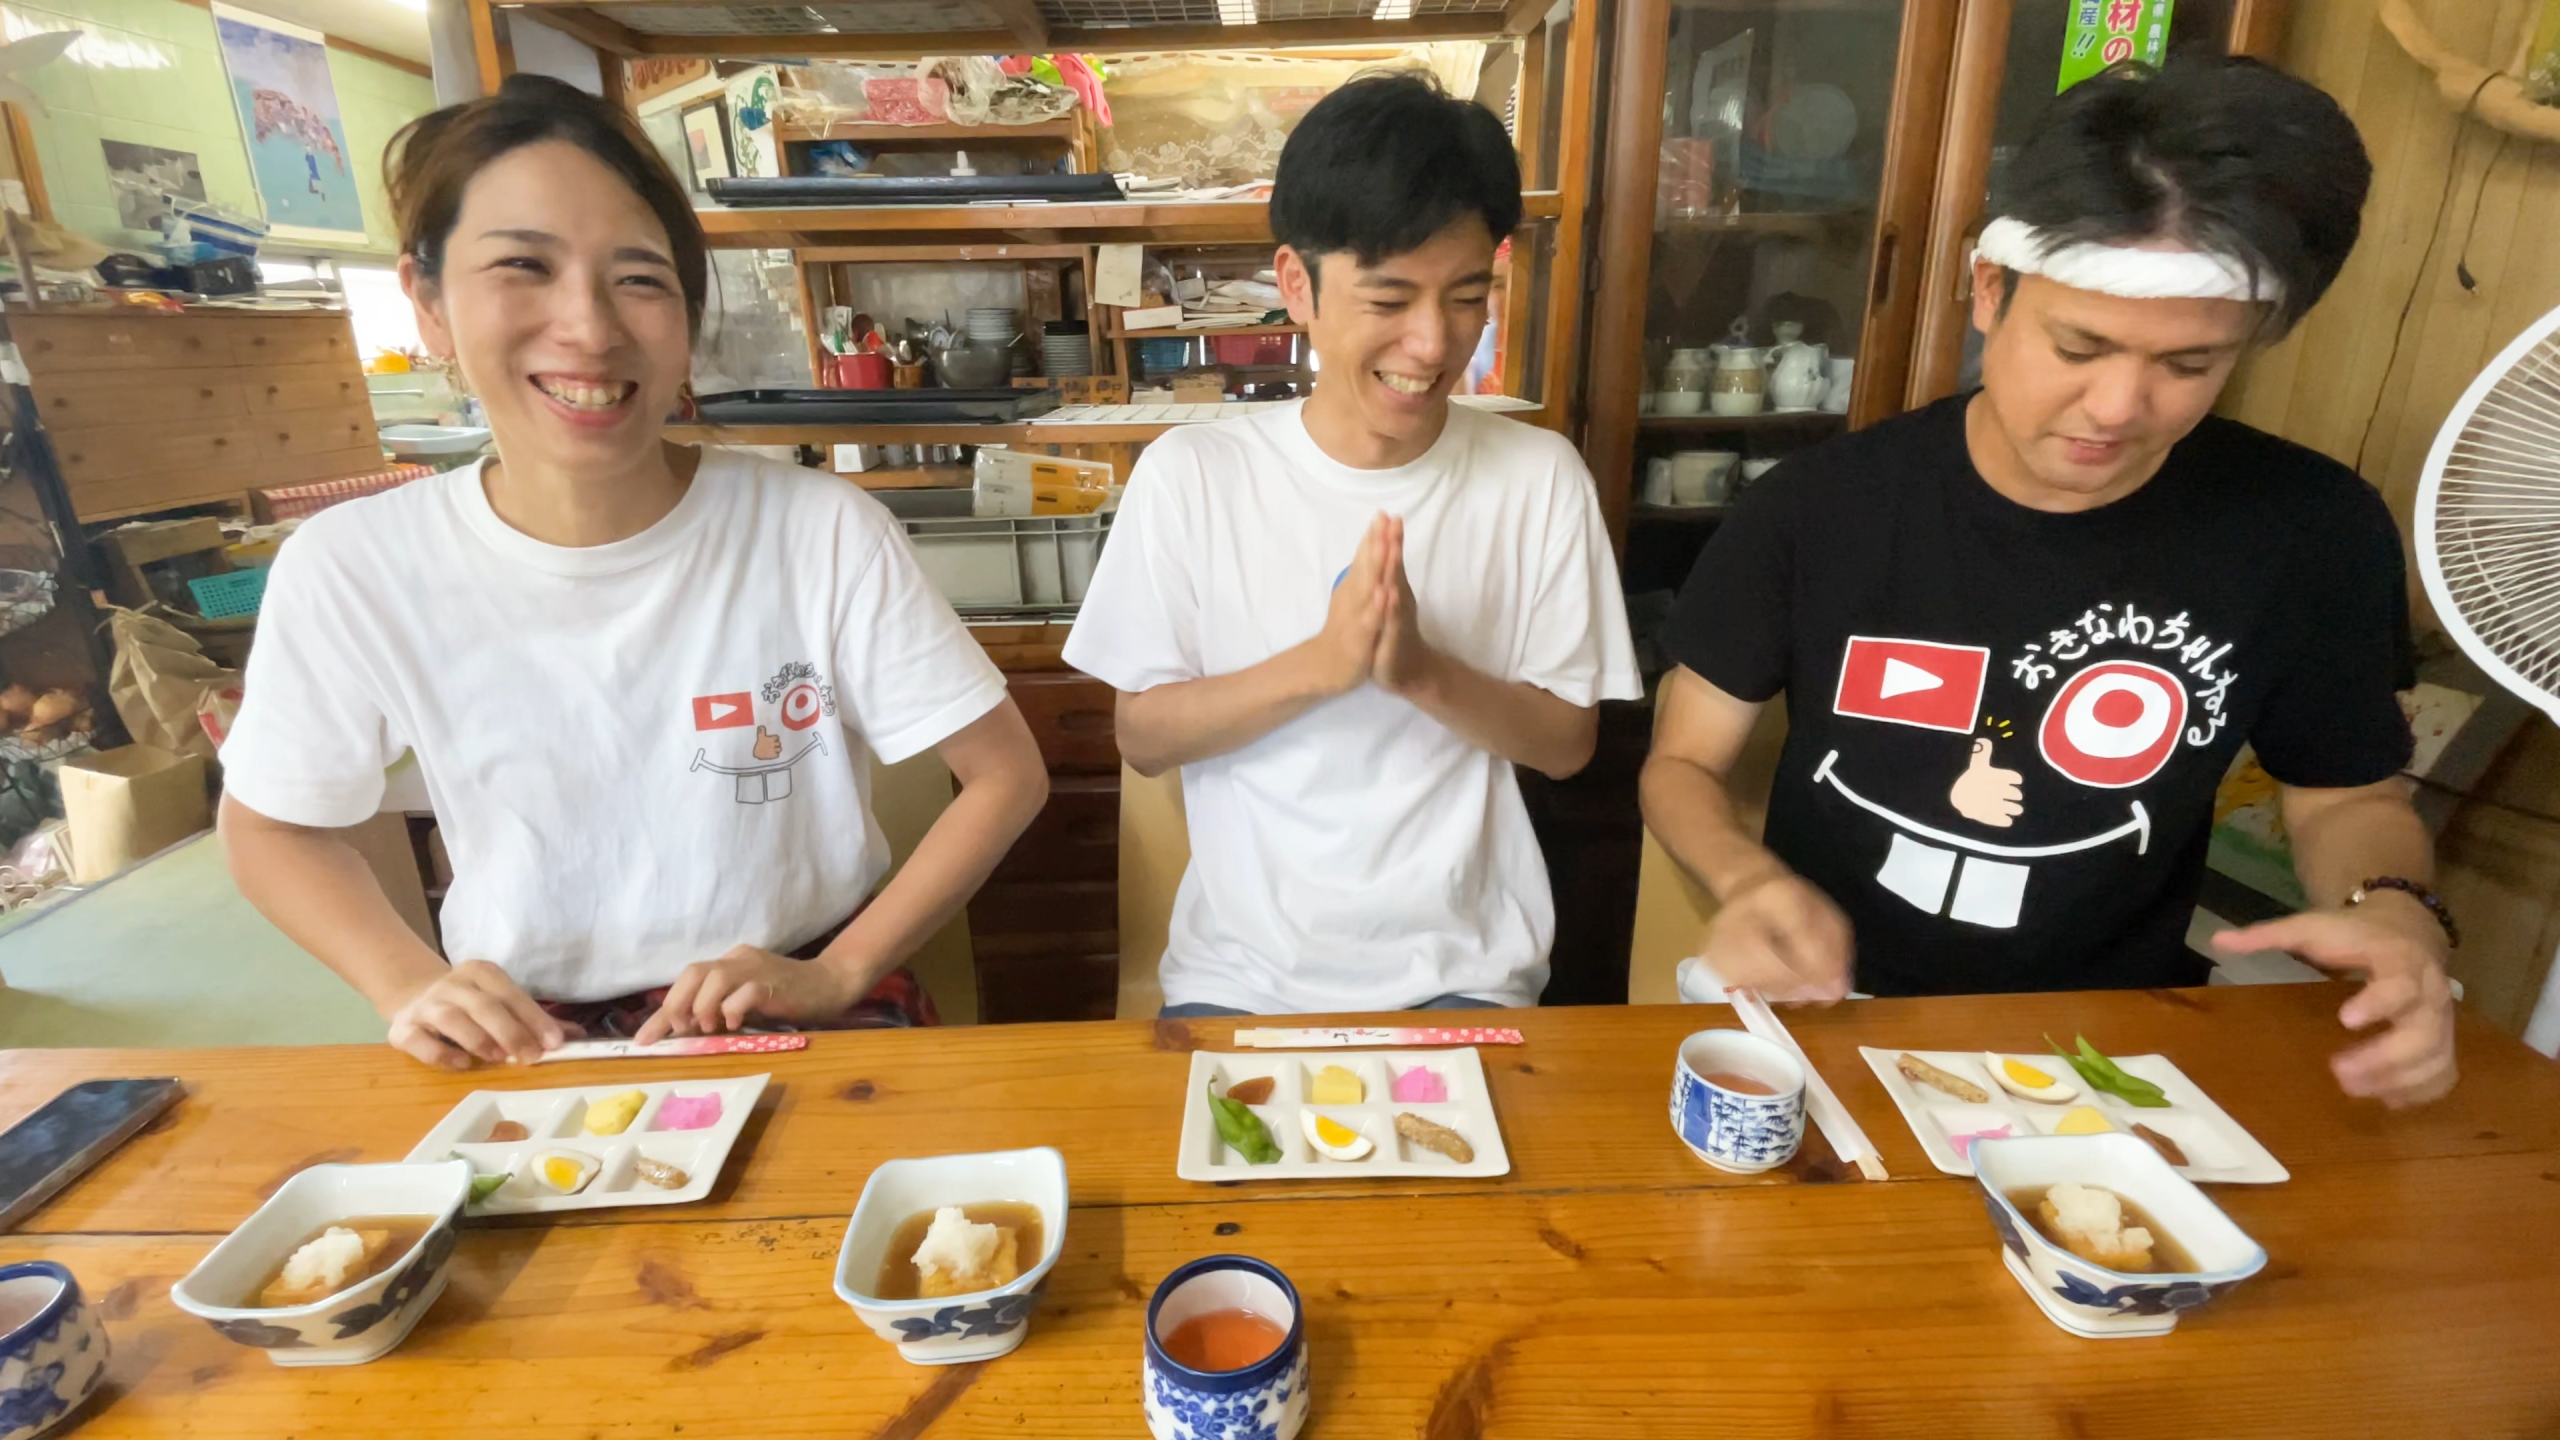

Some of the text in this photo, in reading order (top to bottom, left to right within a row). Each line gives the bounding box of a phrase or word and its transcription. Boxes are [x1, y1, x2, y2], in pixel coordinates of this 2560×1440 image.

[2010, 602, 2239, 748] おきなわちゃんねる
